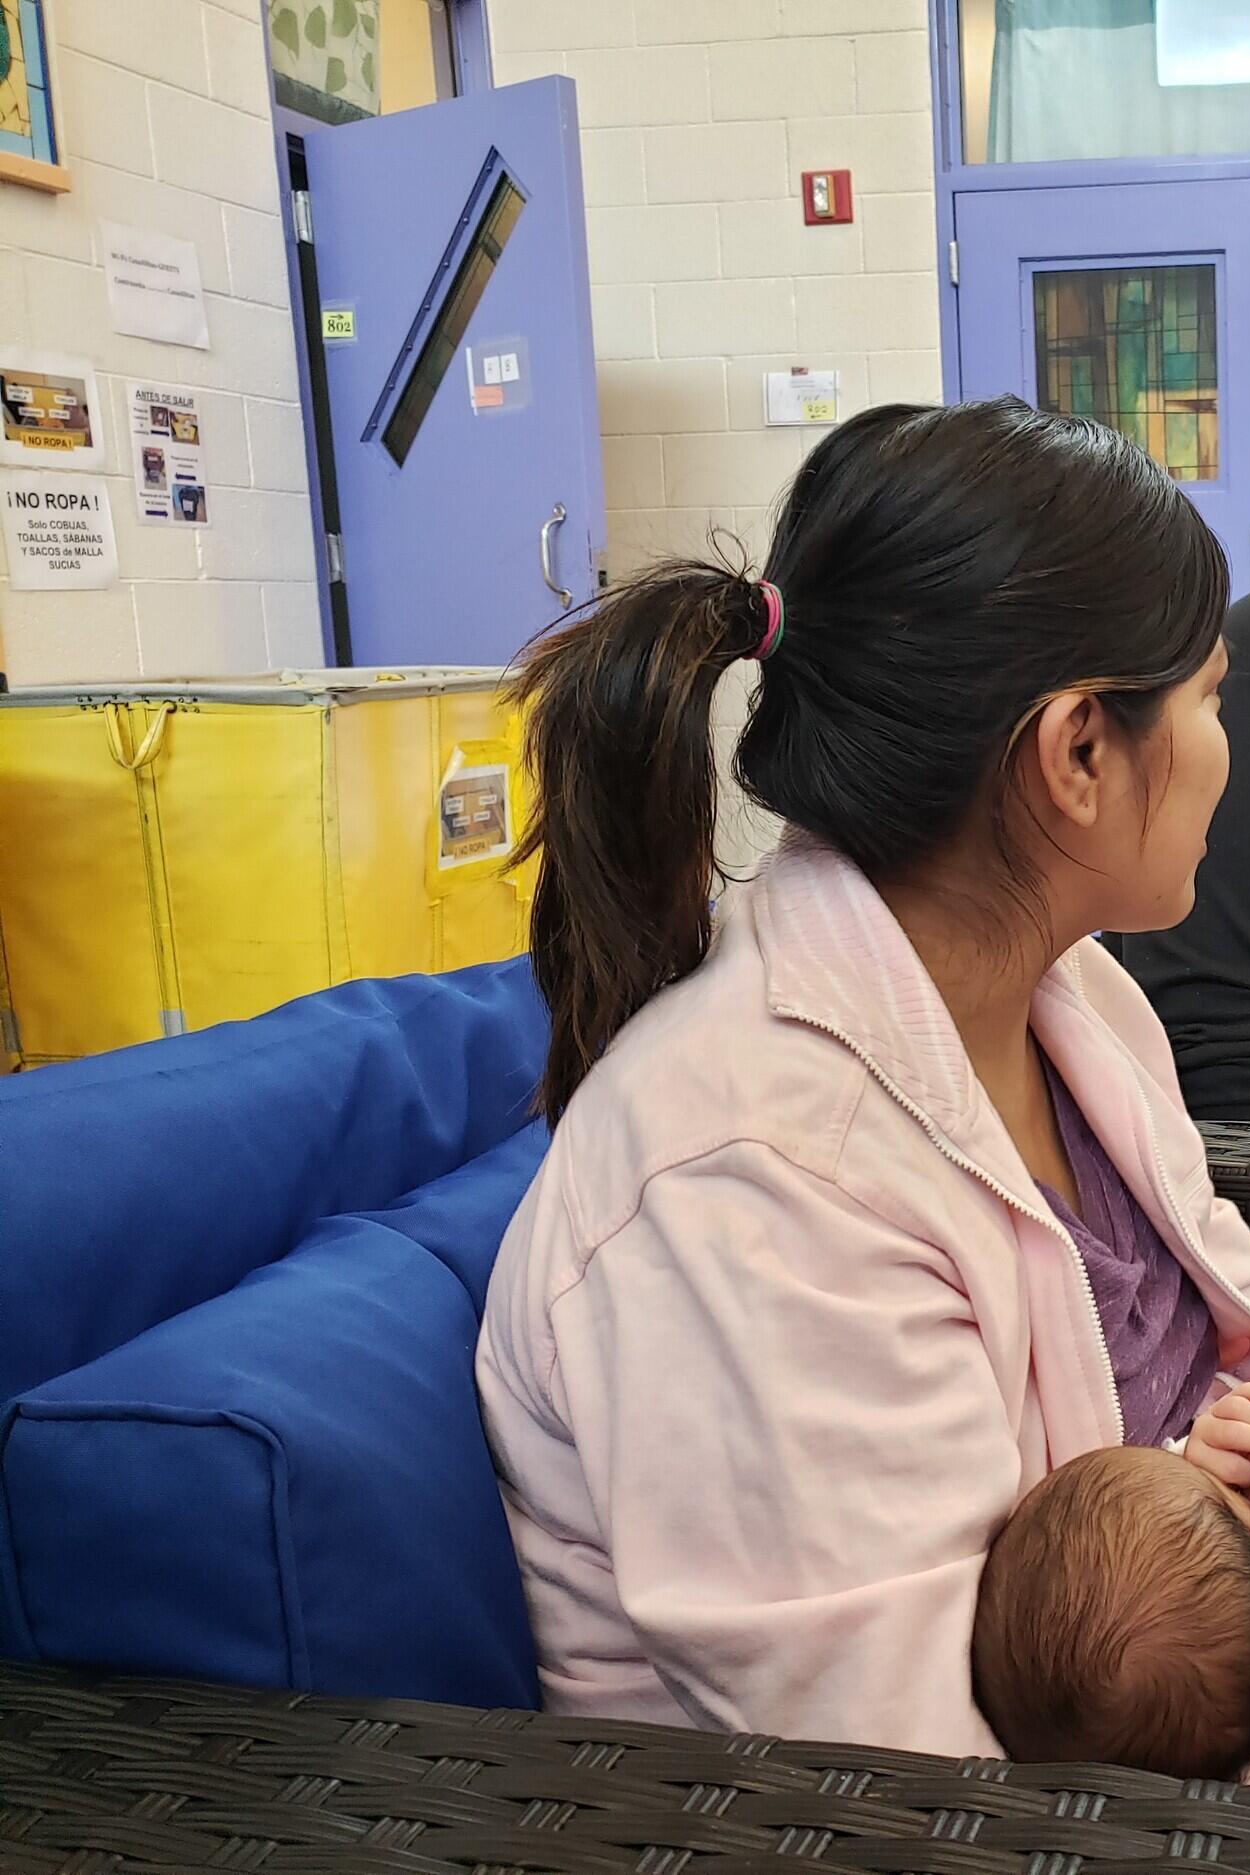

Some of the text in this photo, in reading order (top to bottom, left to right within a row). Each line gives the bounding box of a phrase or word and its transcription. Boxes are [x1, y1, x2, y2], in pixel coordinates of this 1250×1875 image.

[327, 319, 352, 333] 802
[135, 389, 160, 402] ANTES
[173, 396, 194, 408] SALIR
[28, 520, 47, 529] Solo
[29, 547, 61, 556] SACOS
[63, 547, 72, 556] de
[74, 547, 104, 556] MALLA
[49, 560, 81, 570] SUCIAS
